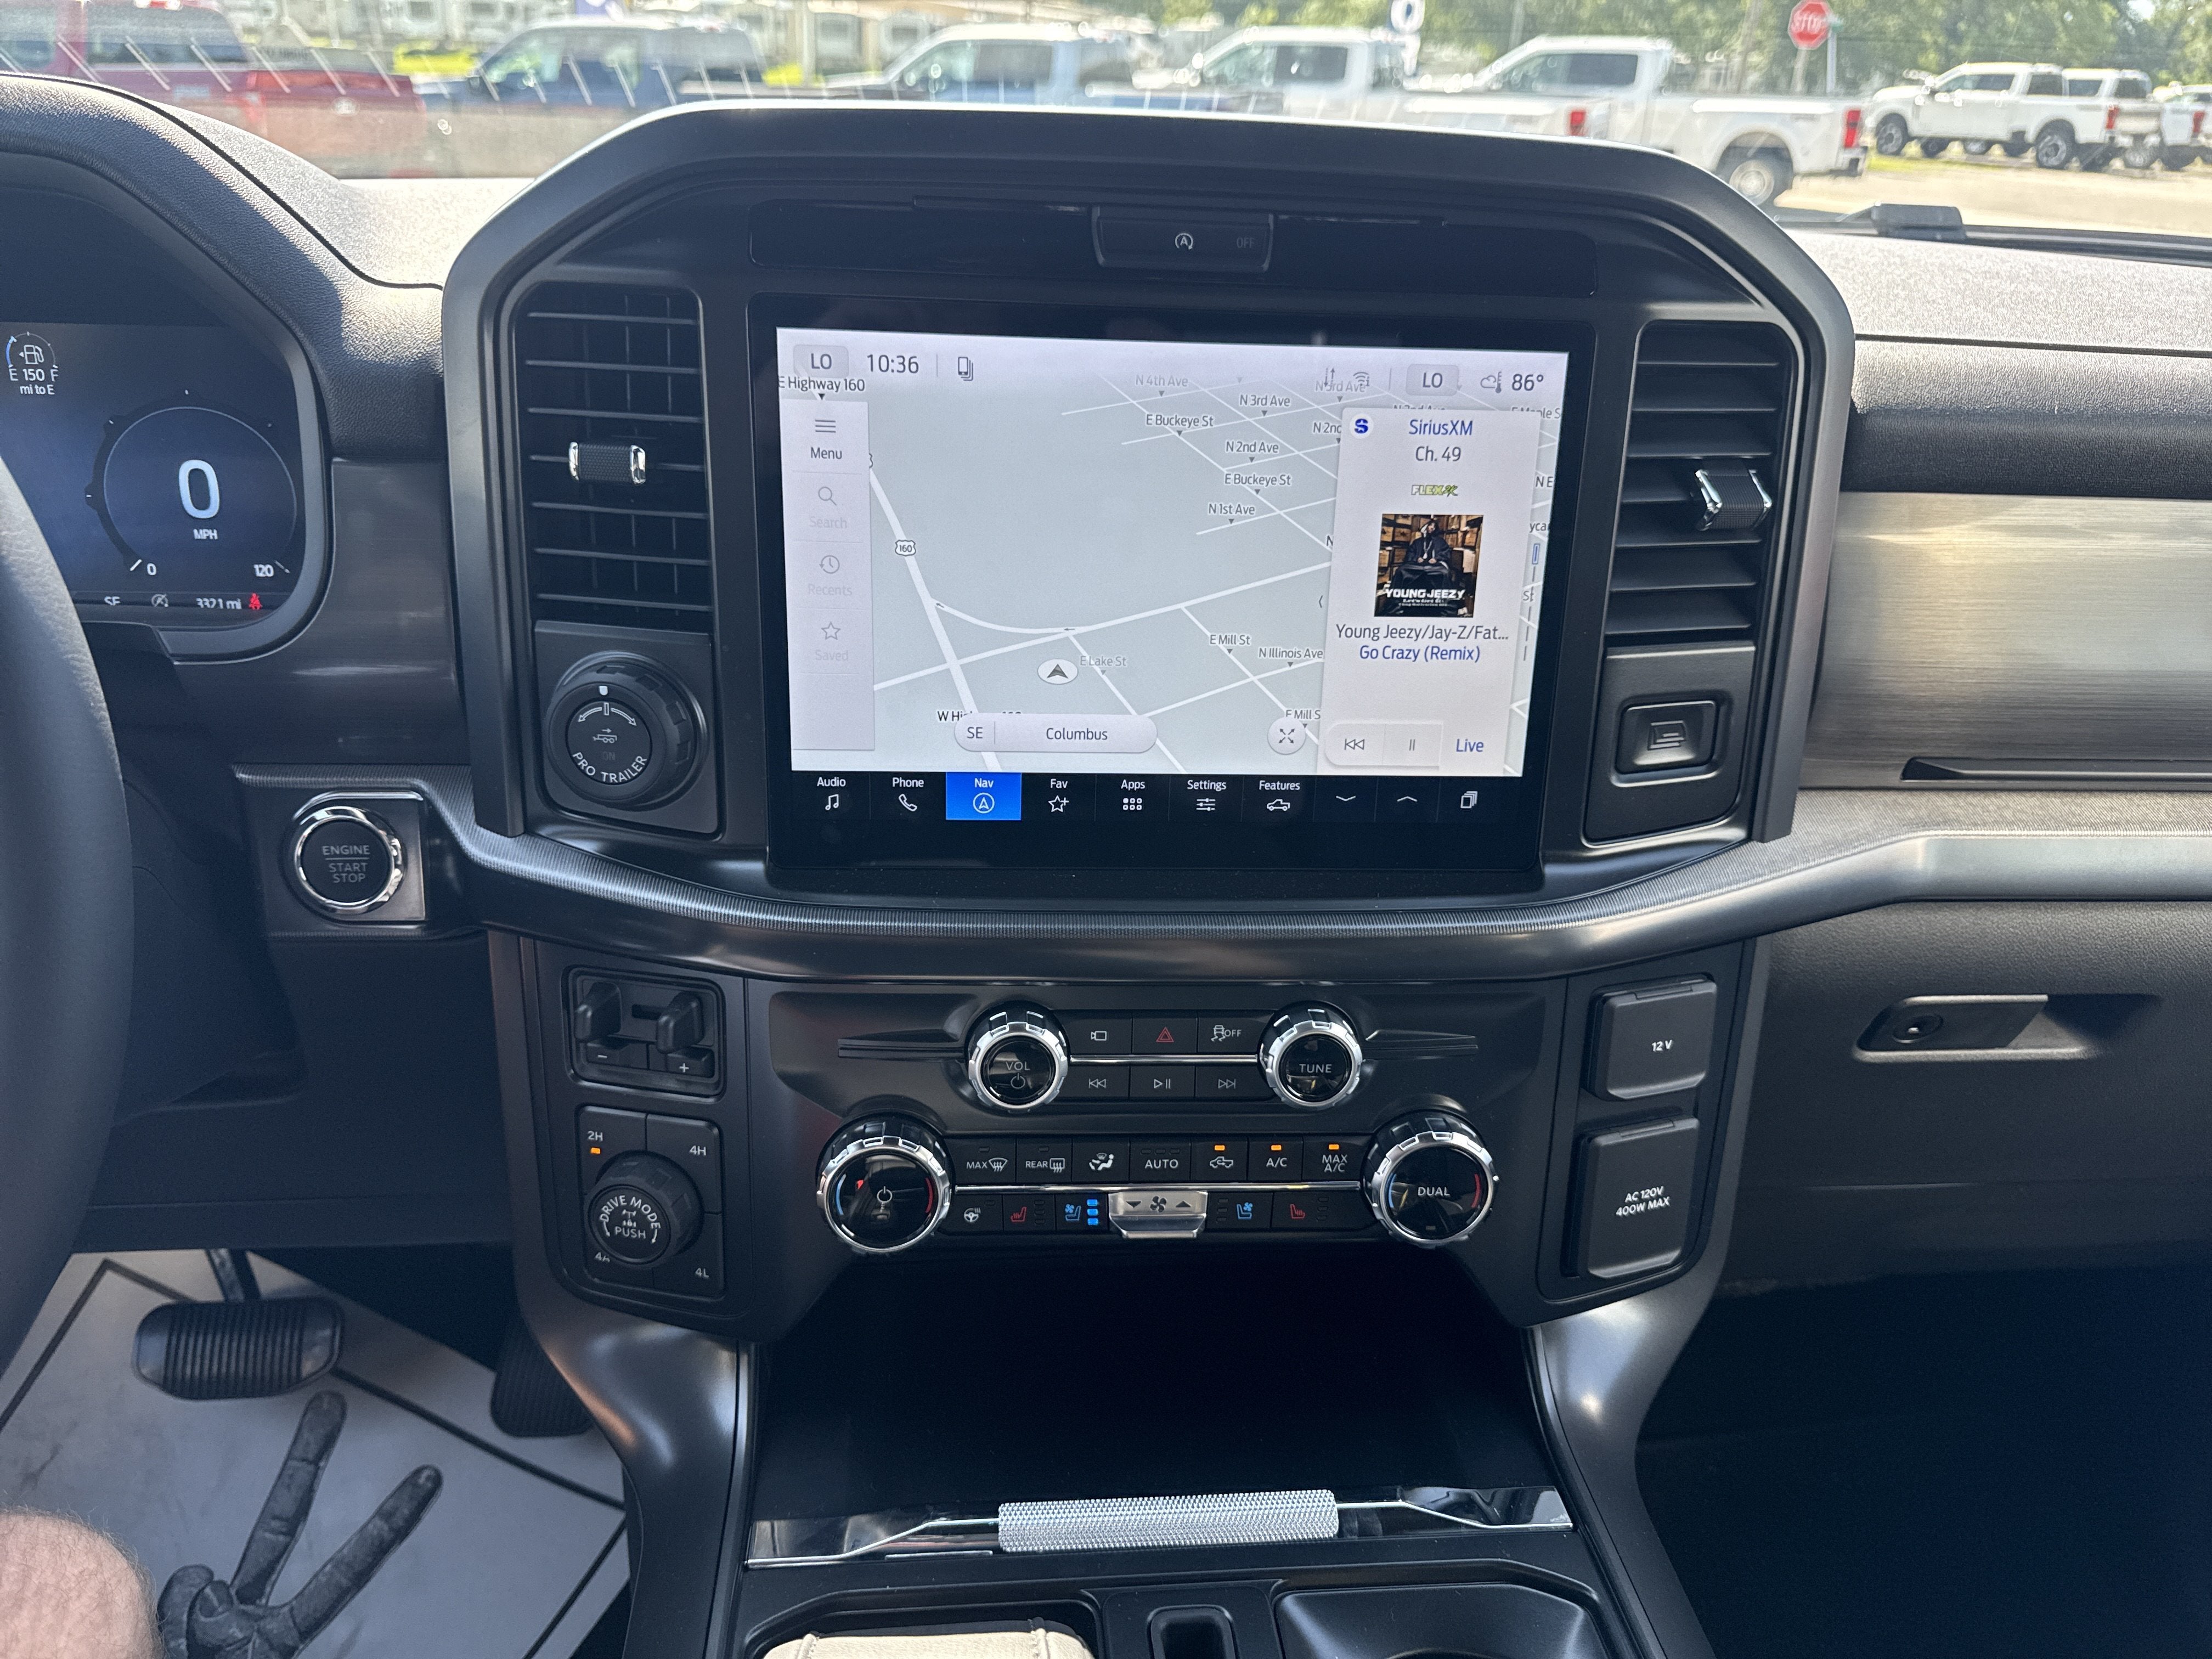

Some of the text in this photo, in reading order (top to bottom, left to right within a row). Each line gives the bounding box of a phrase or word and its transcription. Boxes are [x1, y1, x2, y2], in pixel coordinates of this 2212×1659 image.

[1236, 236, 1255, 249] OFF
[810, 353, 832, 370] LO
[867, 354, 919, 374] 10:36
[9, 368, 59, 382] E 150 F
[1423, 372, 1443, 388] LO
[788, 376, 840, 392] Highway
[844, 379, 865, 391] 160
[1136, 375, 1144, 385] N
[1167, 375, 1188, 387] Ave
[1511, 374, 1544, 391] 86°
[20, 384, 55, 395] mi to E
[1345, 382, 1365, 392] Ave
[1240, 395, 1290, 407] N 3rd Ave
[1146, 414, 1214, 429] E Buckeye St
[1313, 422, 1321, 433] N
[1409, 419, 1473, 436] SiriusXM
[1226, 441, 1279, 453] N 2nd Ave
[810, 447, 843, 460] Menu
[1415, 447, 1461, 462] Ch. 49
[1225, 473, 1291, 487] E Buckeye St
[1536, 476, 1544, 487] N
[178, 459, 220, 518] 0
[1209, 504, 1255, 515] N 1st Ave
[809, 516, 848, 529] Search
[193, 529, 218, 539] MPH
[900, 545, 912, 553] 160
[146, 563, 157, 575] 0
[253, 564, 275, 577] 120
[808, 584, 852, 596] Recents
[1386, 589, 1465, 600] YOUNG JEEZY
[225, 597, 242, 610] mi
[1336, 624, 1380, 641] Young
[1210, 635, 1251, 646] E Mill St
[815, 650, 849, 661] Saved
[1259, 648, 1323, 659] N Illinois Ave
[1359, 645, 1481, 663] Go Crazy (Remix)
[1080, 656, 1127, 667] E Lake St
[937, 711, 949, 721] W
[1294, 709, 1312, 719] Mill
[967, 726, 983, 739] SE
[1046, 727, 1108, 740] Columbus
[1456, 738, 1484, 752] Live
[572, 752, 647, 783] PRO TRAILER
[817, 777, 846, 787] Audio
[892, 777, 924, 788] Phone
[974, 778, 994, 788] Nav
[1050, 779, 1068, 789] Fav
[1121, 779, 1146, 791] Apps
[1187, 779, 1227, 792] Settings
[1259, 780, 1300, 791] Features
[322, 845, 370, 855] ENGINE
[329, 862, 368, 872] START
[332, 873, 365, 883] STOP
[1224, 1028, 1242, 1038] OFF
[1652, 1040, 1673, 1052] 12 V
[1006, 1062, 1030, 1071] VOL
[1299, 1064, 1332, 1074] TUNE
[588, 1131, 603, 1142] 2H
[689, 1145, 707, 1156] 4H
[1144, 1159, 1178, 1169] AUTO
[1266, 1158, 1288, 1168] A/C
[1322, 1154, 1347, 1164] MAX
[966, 1161, 987, 1169] MAX
[1025, 1161, 1048, 1169] REAR
[1324, 1163, 1346, 1173] A/C
[1418, 1186, 1450, 1197] DUAL
[1625, 1186, 1665, 1203] AC 120V
[1616, 1195, 1671, 1217] 400W MAX
[599, 1195, 661, 1229] DRIVE MODE
[614, 1226, 646, 1239] PUSH
[695, 1267, 710, 1278] 4L
